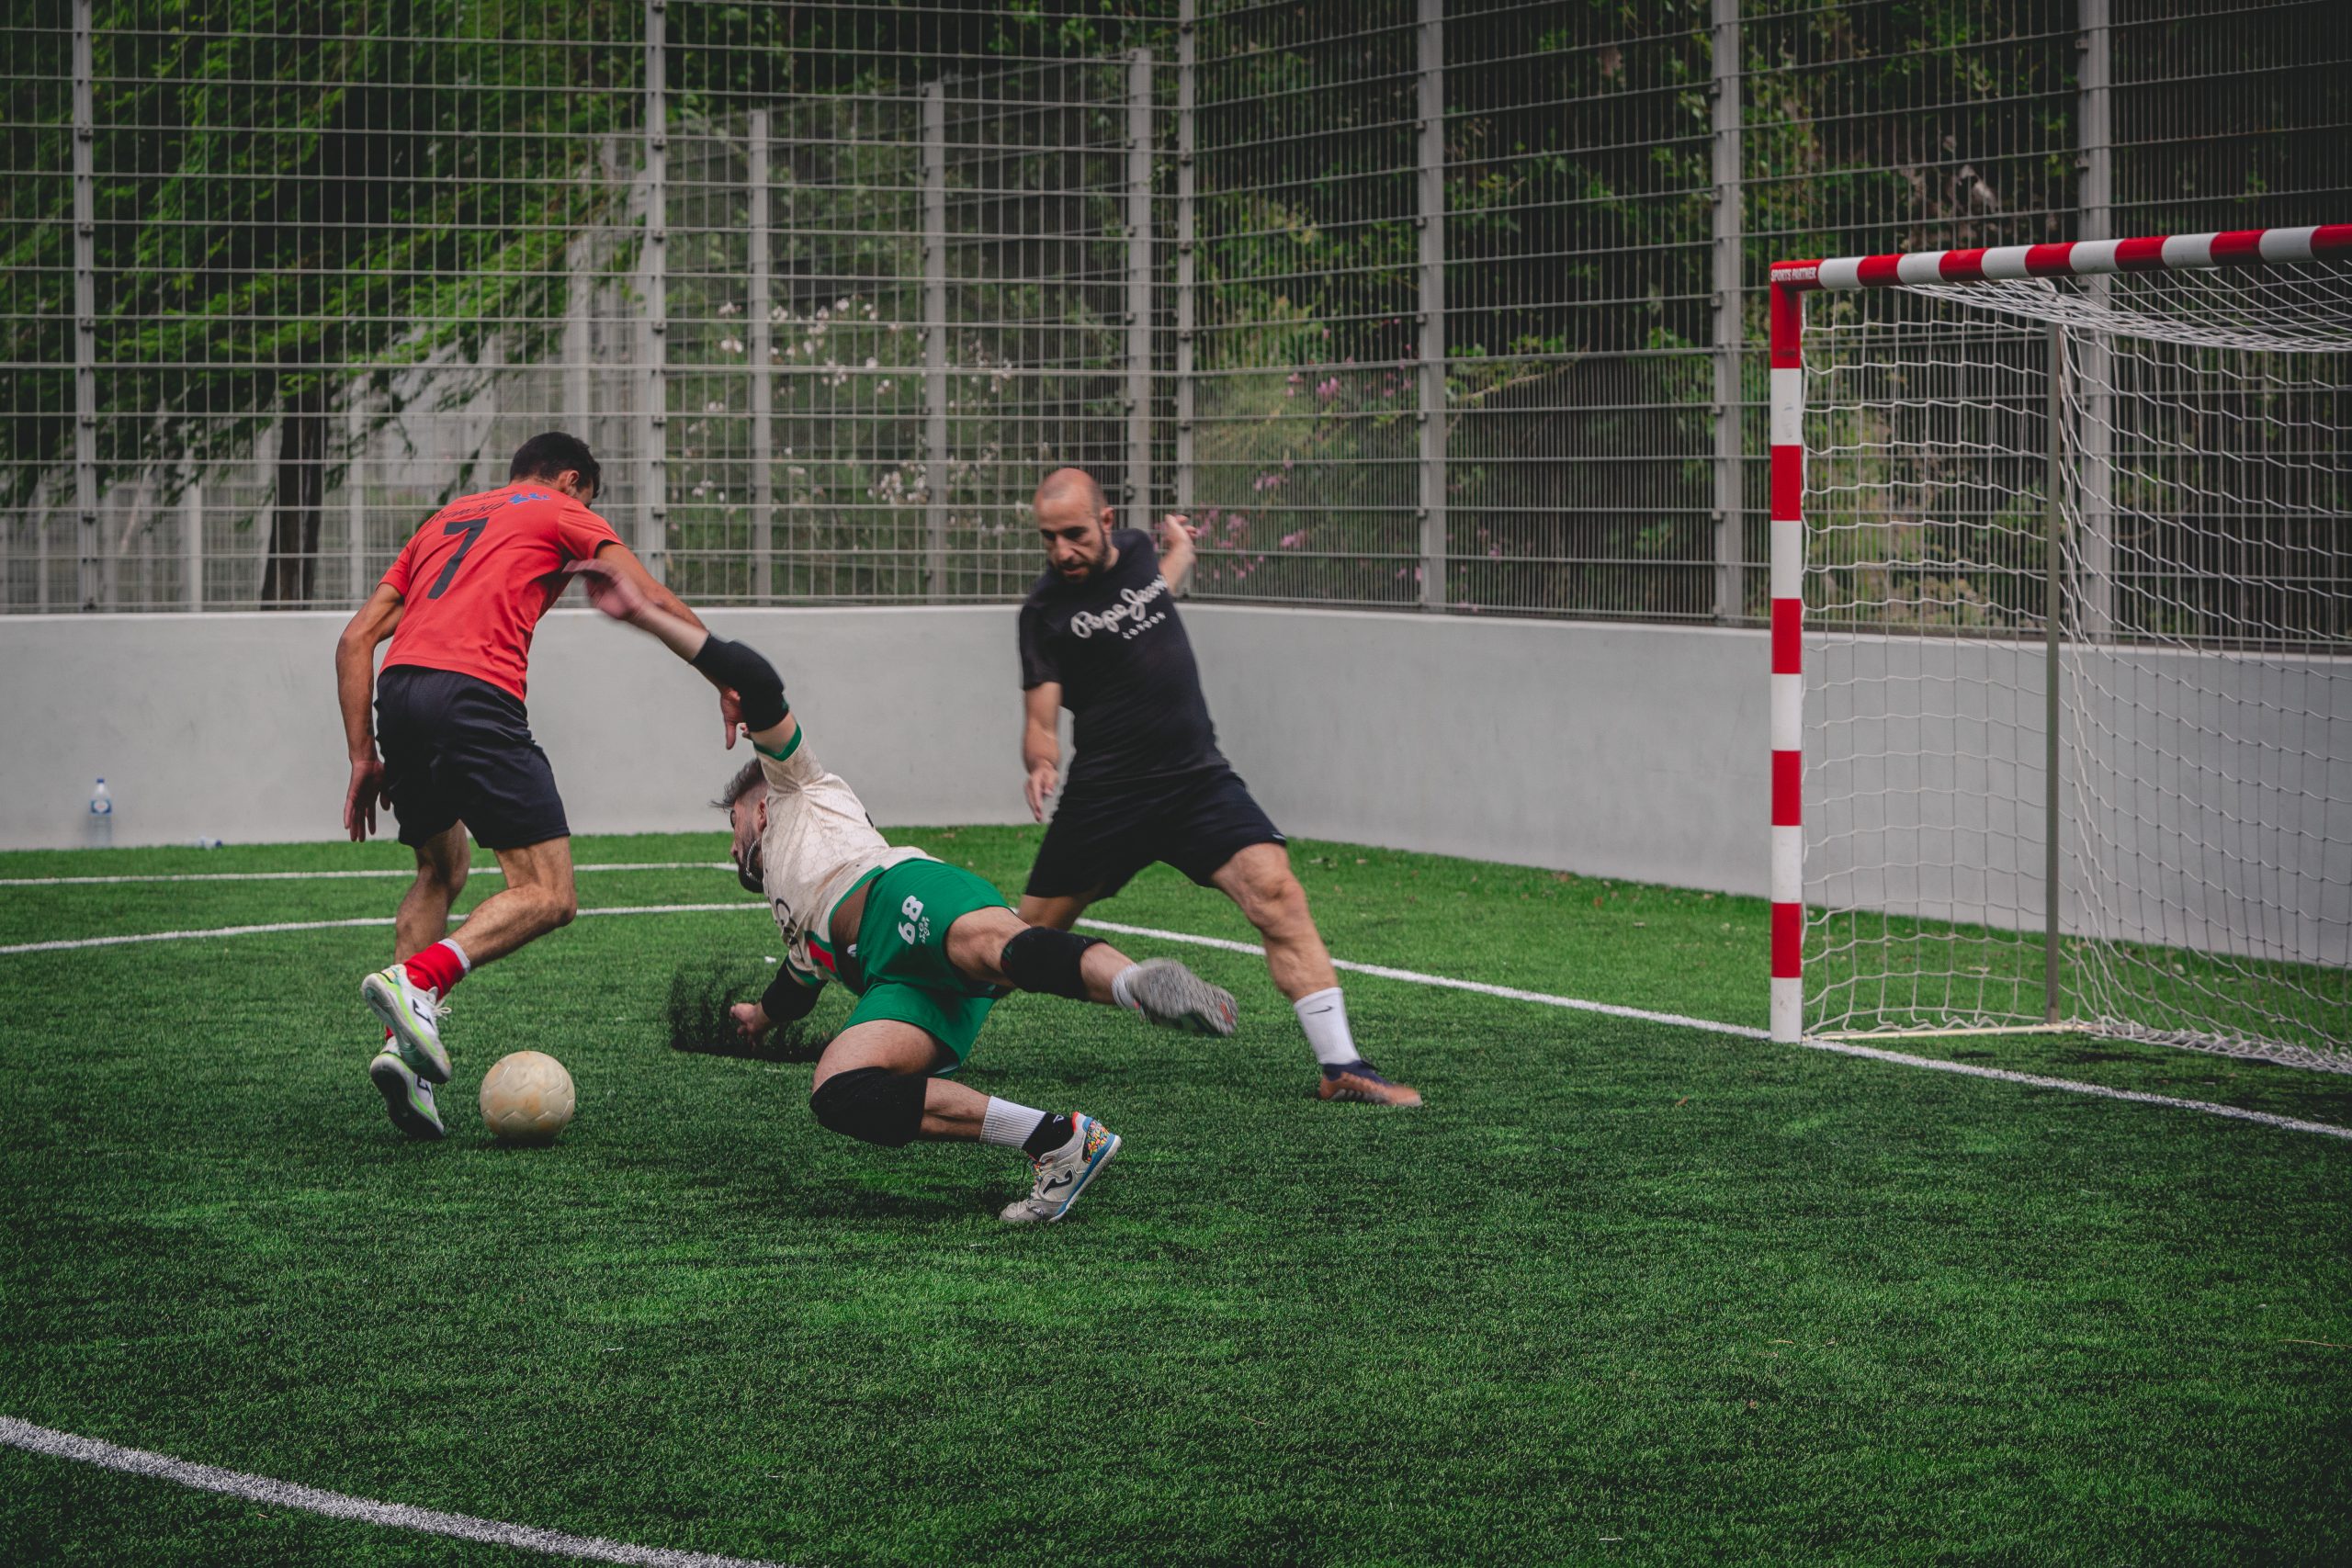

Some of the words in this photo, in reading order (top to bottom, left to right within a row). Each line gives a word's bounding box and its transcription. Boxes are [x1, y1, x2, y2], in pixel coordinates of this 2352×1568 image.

[1770, 268, 1792, 282] SPORTS
[426, 516, 490, 600] 7
[1070, 604, 1129, 638] Pepe
[898, 895, 924, 945] 68
